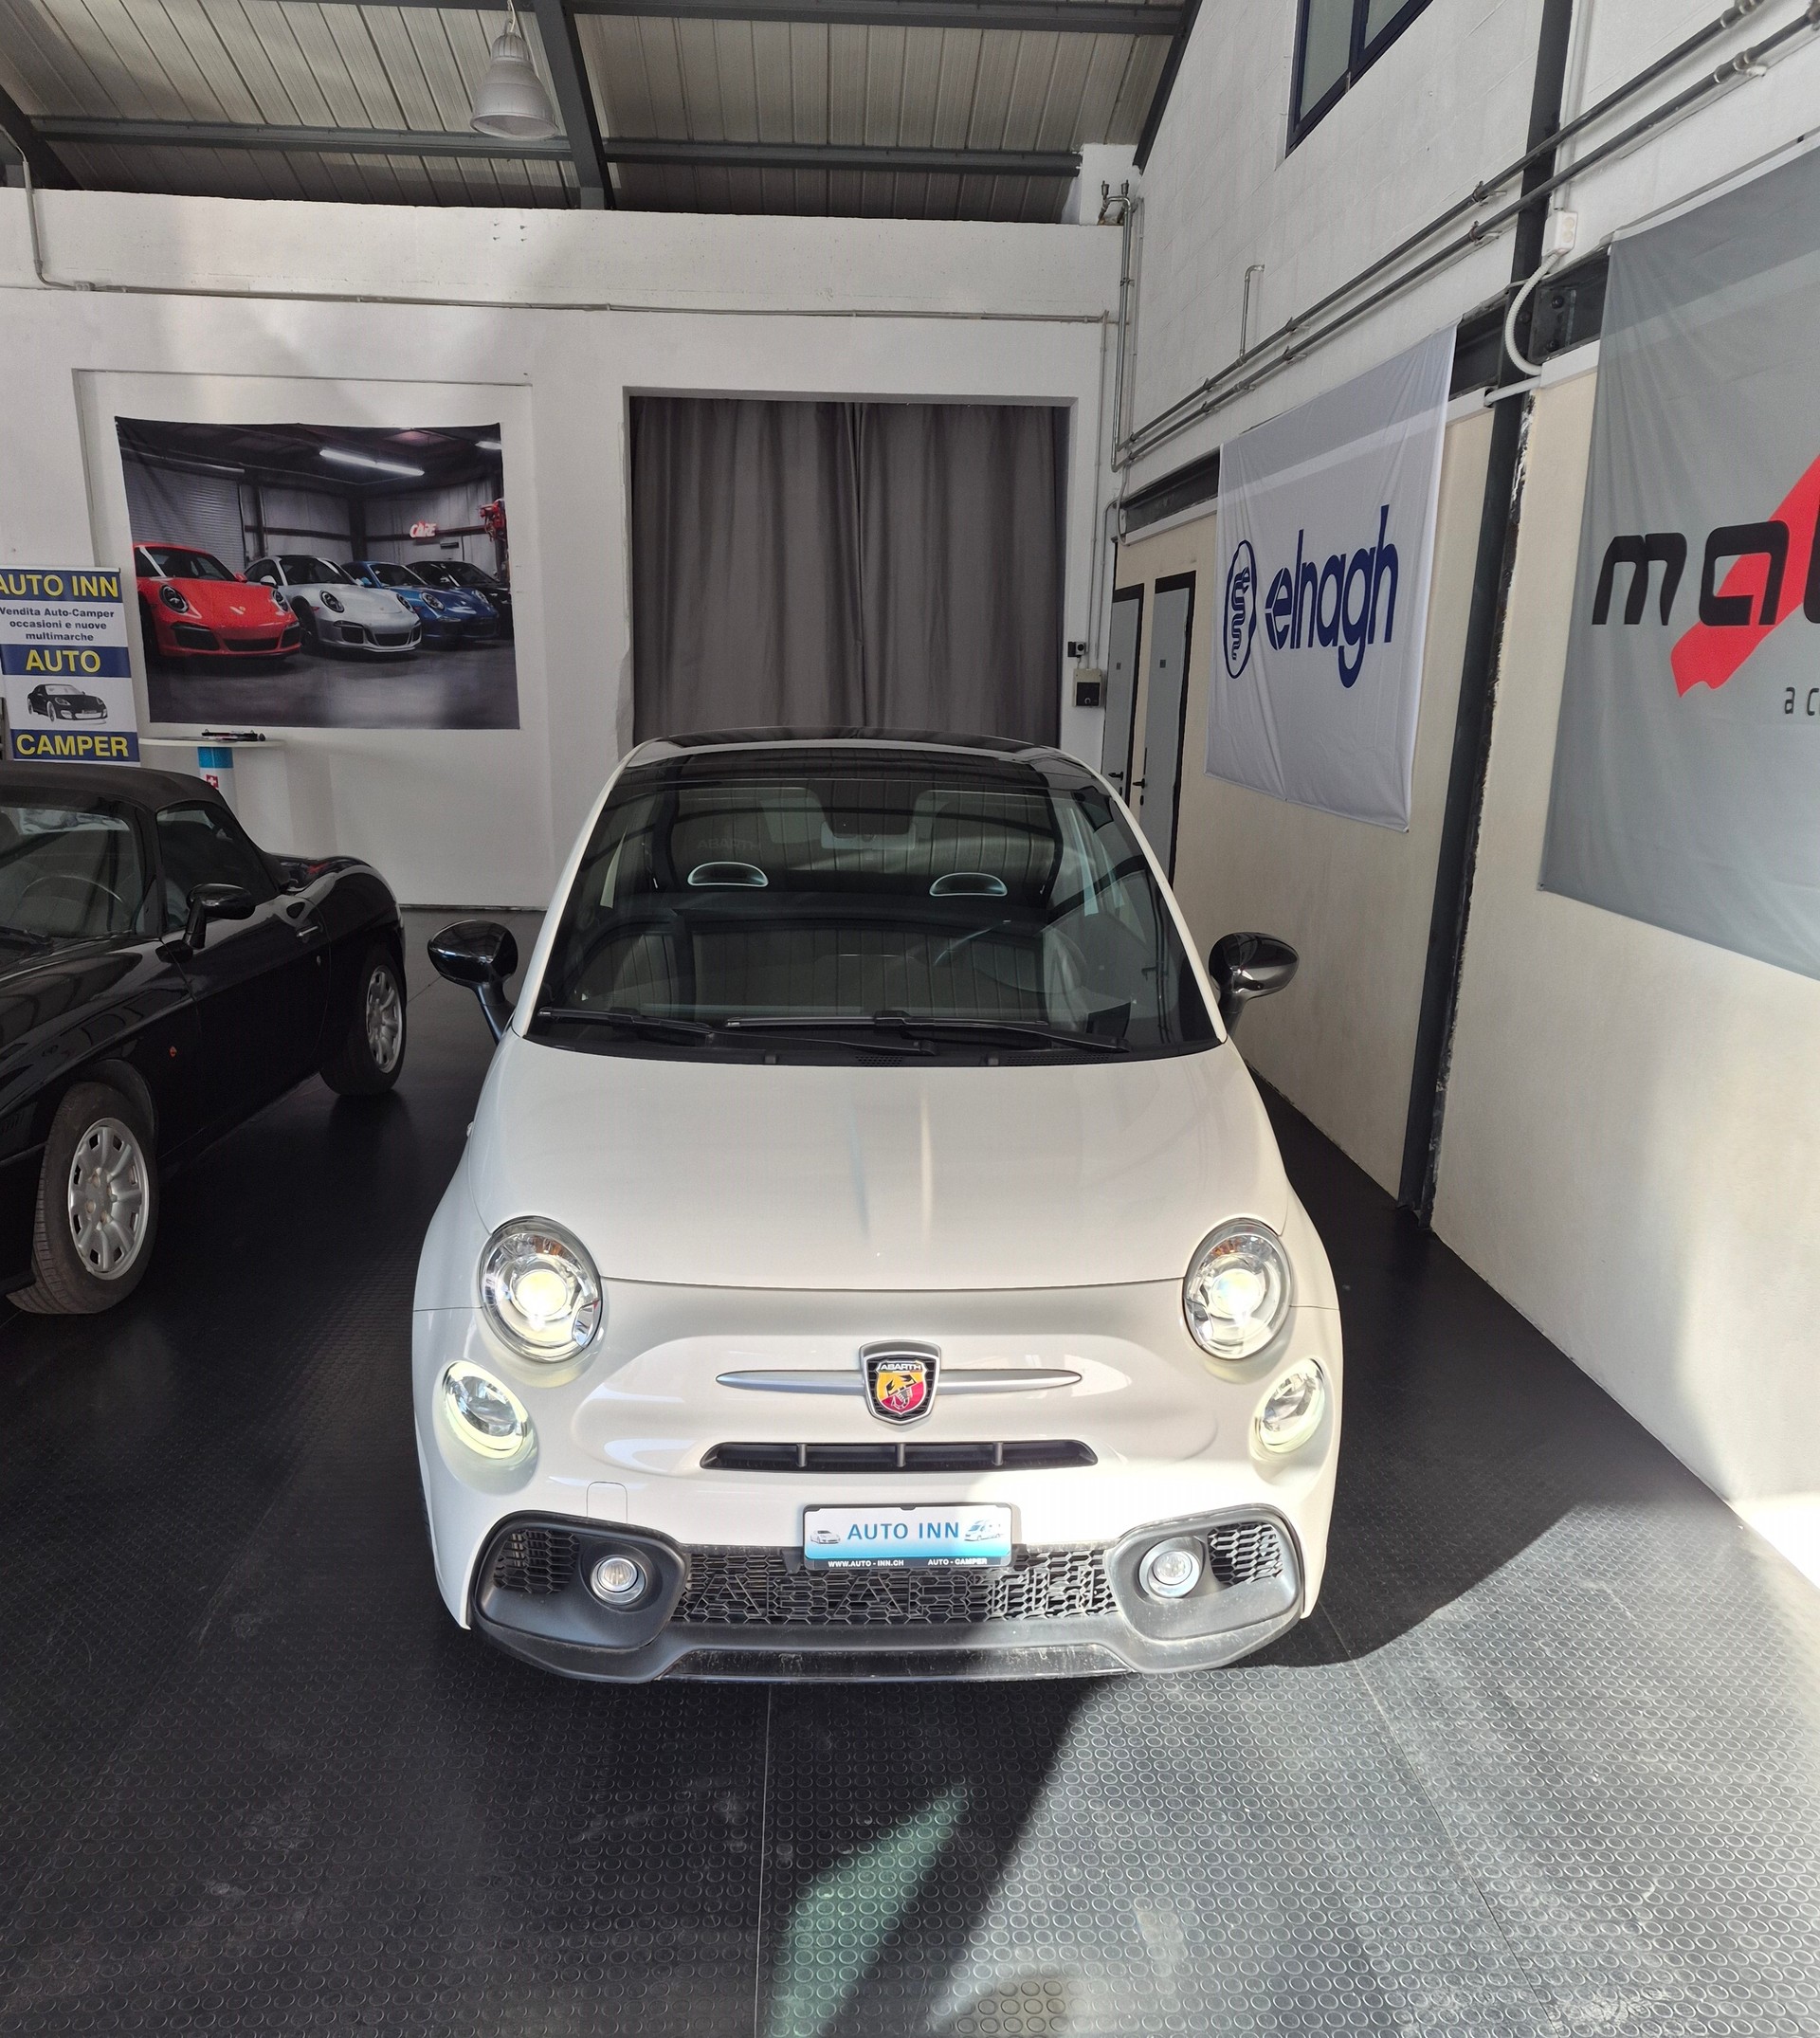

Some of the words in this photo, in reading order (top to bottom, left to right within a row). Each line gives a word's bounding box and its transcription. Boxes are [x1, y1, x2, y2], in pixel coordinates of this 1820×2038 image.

[72, 575, 118, 597] INN
[1265, 503, 1399, 688] elnagh
[9, 619, 63, 628] occasioni
[45, 608, 115, 619] Auto-Camper
[26, 631, 94, 642] multimarche
[26, 649, 101, 673] AUTO
[16, 734, 129, 756] CAMPER
[847, 1523, 909, 1540] AUTO
[919, 1522, 959, 1539] INN
[692, 1566, 1095, 1615] ABARTH
